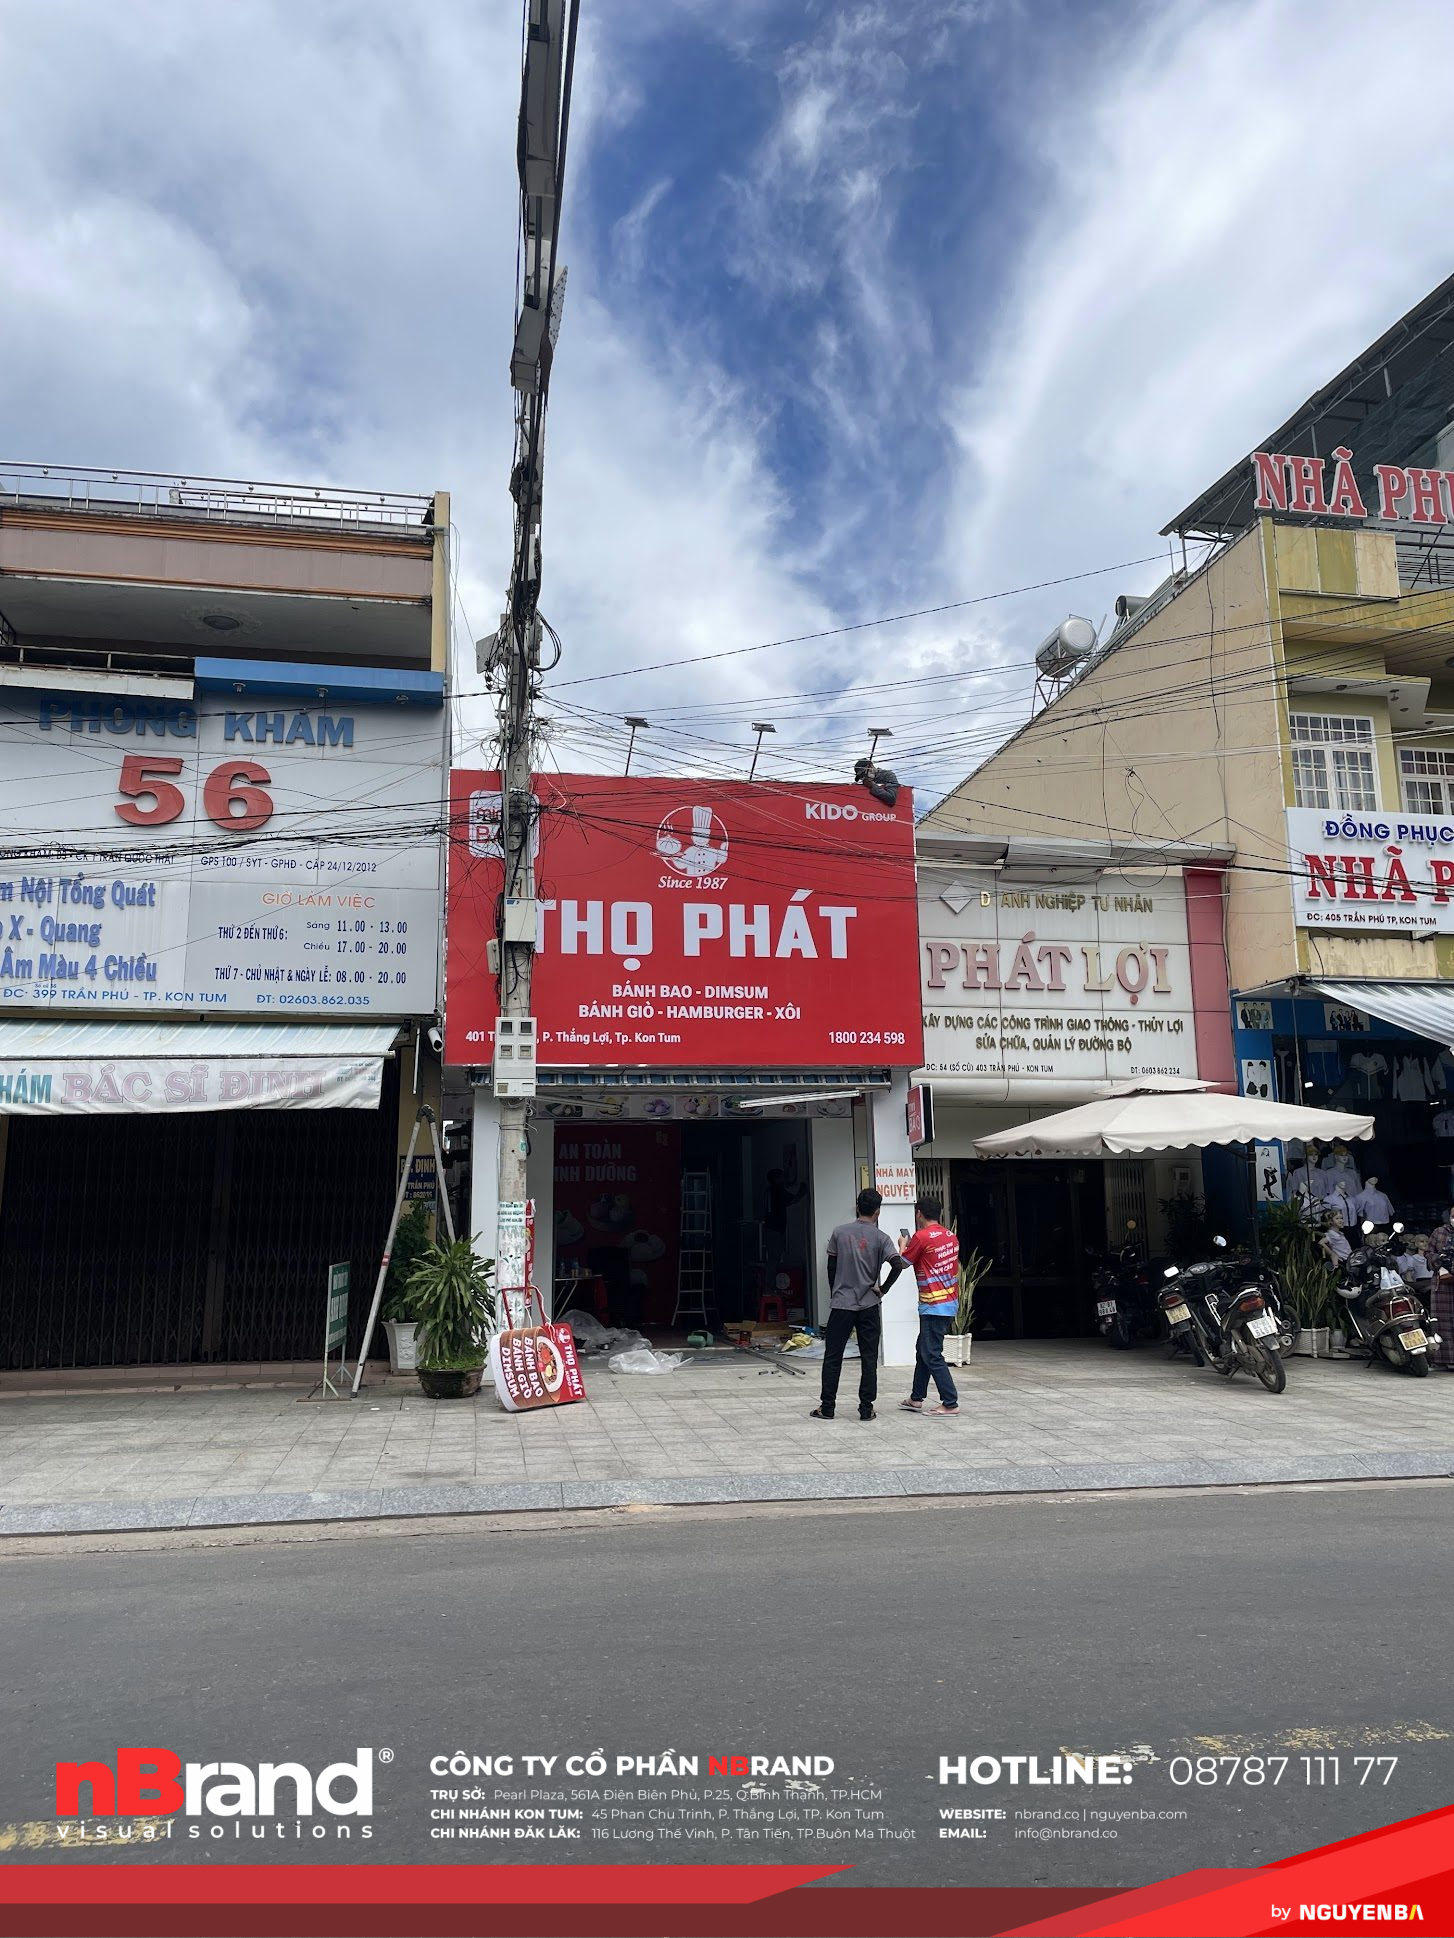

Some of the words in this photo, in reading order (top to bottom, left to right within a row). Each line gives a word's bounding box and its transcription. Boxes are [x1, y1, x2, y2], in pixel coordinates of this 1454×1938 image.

[1250, 446, 1367, 517] NHÃ
[224, 710, 354, 747] KHÁM
[805, 802, 858, 821] KIDO
[861, 811, 896, 822] GROUP
[1323, 813, 1390, 839] ĐỒNG
[246, 857, 262, 868] SYT
[658, 875, 692, 889] Since
[696, 877, 728, 890] 1987
[1303, 844, 1418, 904] NHÃ
[21, 876, 52, 909] Nội
[59, 872, 106, 909] Tổng
[111, 880, 156, 910] Quát
[298, 890, 331, 907] LÀM
[337, 894, 376, 911] VIỆC
[1035, 890, 1086, 913] NGHIỆP
[1114, 893, 1153, 913] NHÂN
[306, 921, 330, 931] Sáng
[683, 889, 858, 959] PHÁT
[1307, 912, 1323, 921] ĐC:
[1325, 913, 1341, 922] 405
[1344, 911, 1365, 923] TRẦN
[1368, 912, 1385, 924] PHÚ
[1400, 915, 1418, 925] KON
[1420, 916, 1437, 925] TUM
[40, 915, 102, 948] Quang
[0, 946, 33, 979] Âm
[38, 953, 79, 980] Màu
[84, 954, 98, 981] 4
[104, 952, 157, 982] Chiều
[926, 930, 1072, 991] PHÁT
[1081, 940, 1172, 1005] LỢI
[264, 966, 285, 984] NHẬT
[287, 969, 293, 982] &
[295, 966, 316, 983] NGÀY
[33, 989, 57, 999] 399
[102, 988, 129, 1001] PHÚ
[144, 991, 161, 1001] TP.
[166, 992, 194, 1002] KON
[200, 992, 227, 1003] TUM
[256, 994, 275, 1004] ĐT:
[279, 994, 370, 1005] 02603.862.035
[612, 980, 656, 998] BÁNH
[660, 984, 692, 998] BAO
[704, 985, 768, 999] DIMSUM
[579, 1000, 623, 1018] BÁNH
[627, 1001, 654, 1019] GIÒ
[667, 1004, 764, 1020] HAMBURGER
[775, 1002, 801, 1020] XÔI
[944, 1014, 973, 1031] DỰNG
[976, 1013, 998, 1030] CÁC
[1001, 1014, 1031, 1030] CÔNG
[1034, 1015, 1063, 1030] TRÌNH
[1066, 1018, 1091, 1031] GIAO
[1094, 1016, 1130, 1032] THÔNG
[1137, 1016, 1164, 1032] THỦY
[1167, 1019, 1183, 1035] LỢI
[465, 1031, 485, 1042] 401
[542, 1032, 553, 1042] P.
[556, 1028, 590, 1045] Thắng
[592, 1031, 613, 1045] Lợi,
[615, 1032, 632, 1045] Tp.
[635, 1032, 656, 1043] Kon
[658, 1033, 681, 1043] Tum
[828, 1031, 856, 1044] 1800
[859, 1032, 881, 1044] 234
[883, 1032, 905, 1045] 598
[976, 1033, 996, 1049] SỬA
[1000, 1034, 1030, 1051] CHỮA,
[1032, 1033, 1061, 1050] QUẢN
[1065, 1036, 1075, 1050] LÝ
[1079, 1035, 1114, 1051] ĐƯỜNG
[1117, 1037, 1132, 1053] BỘ
[939, 1063, 947, 1071] 54
[976, 1064, 987, 1072] 403
[1026, 1064, 1039, 1073] KON
[1041, 1065, 1054, 1073] TUM
[61, 1064, 152, 1104] BÁC
[164, 1064, 209, 1103] SĨ
[559, 1143, 580, 1160] AN
[584, 1139, 623, 1160] TOÀN
[896, 1167, 914, 1178] MAY
[877, 1181, 915, 1200] NGUYỆT
[512, 1337, 524, 1371] BÁNH
[524, 1336, 536, 1370] BÁNH
[501, 1346, 520, 1398] DIMSUM
[569, 1368, 583, 1397] PHÁT
[517, 1373, 532, 1399] GIÒ
[528, 1372, 543, 1397] BAO
